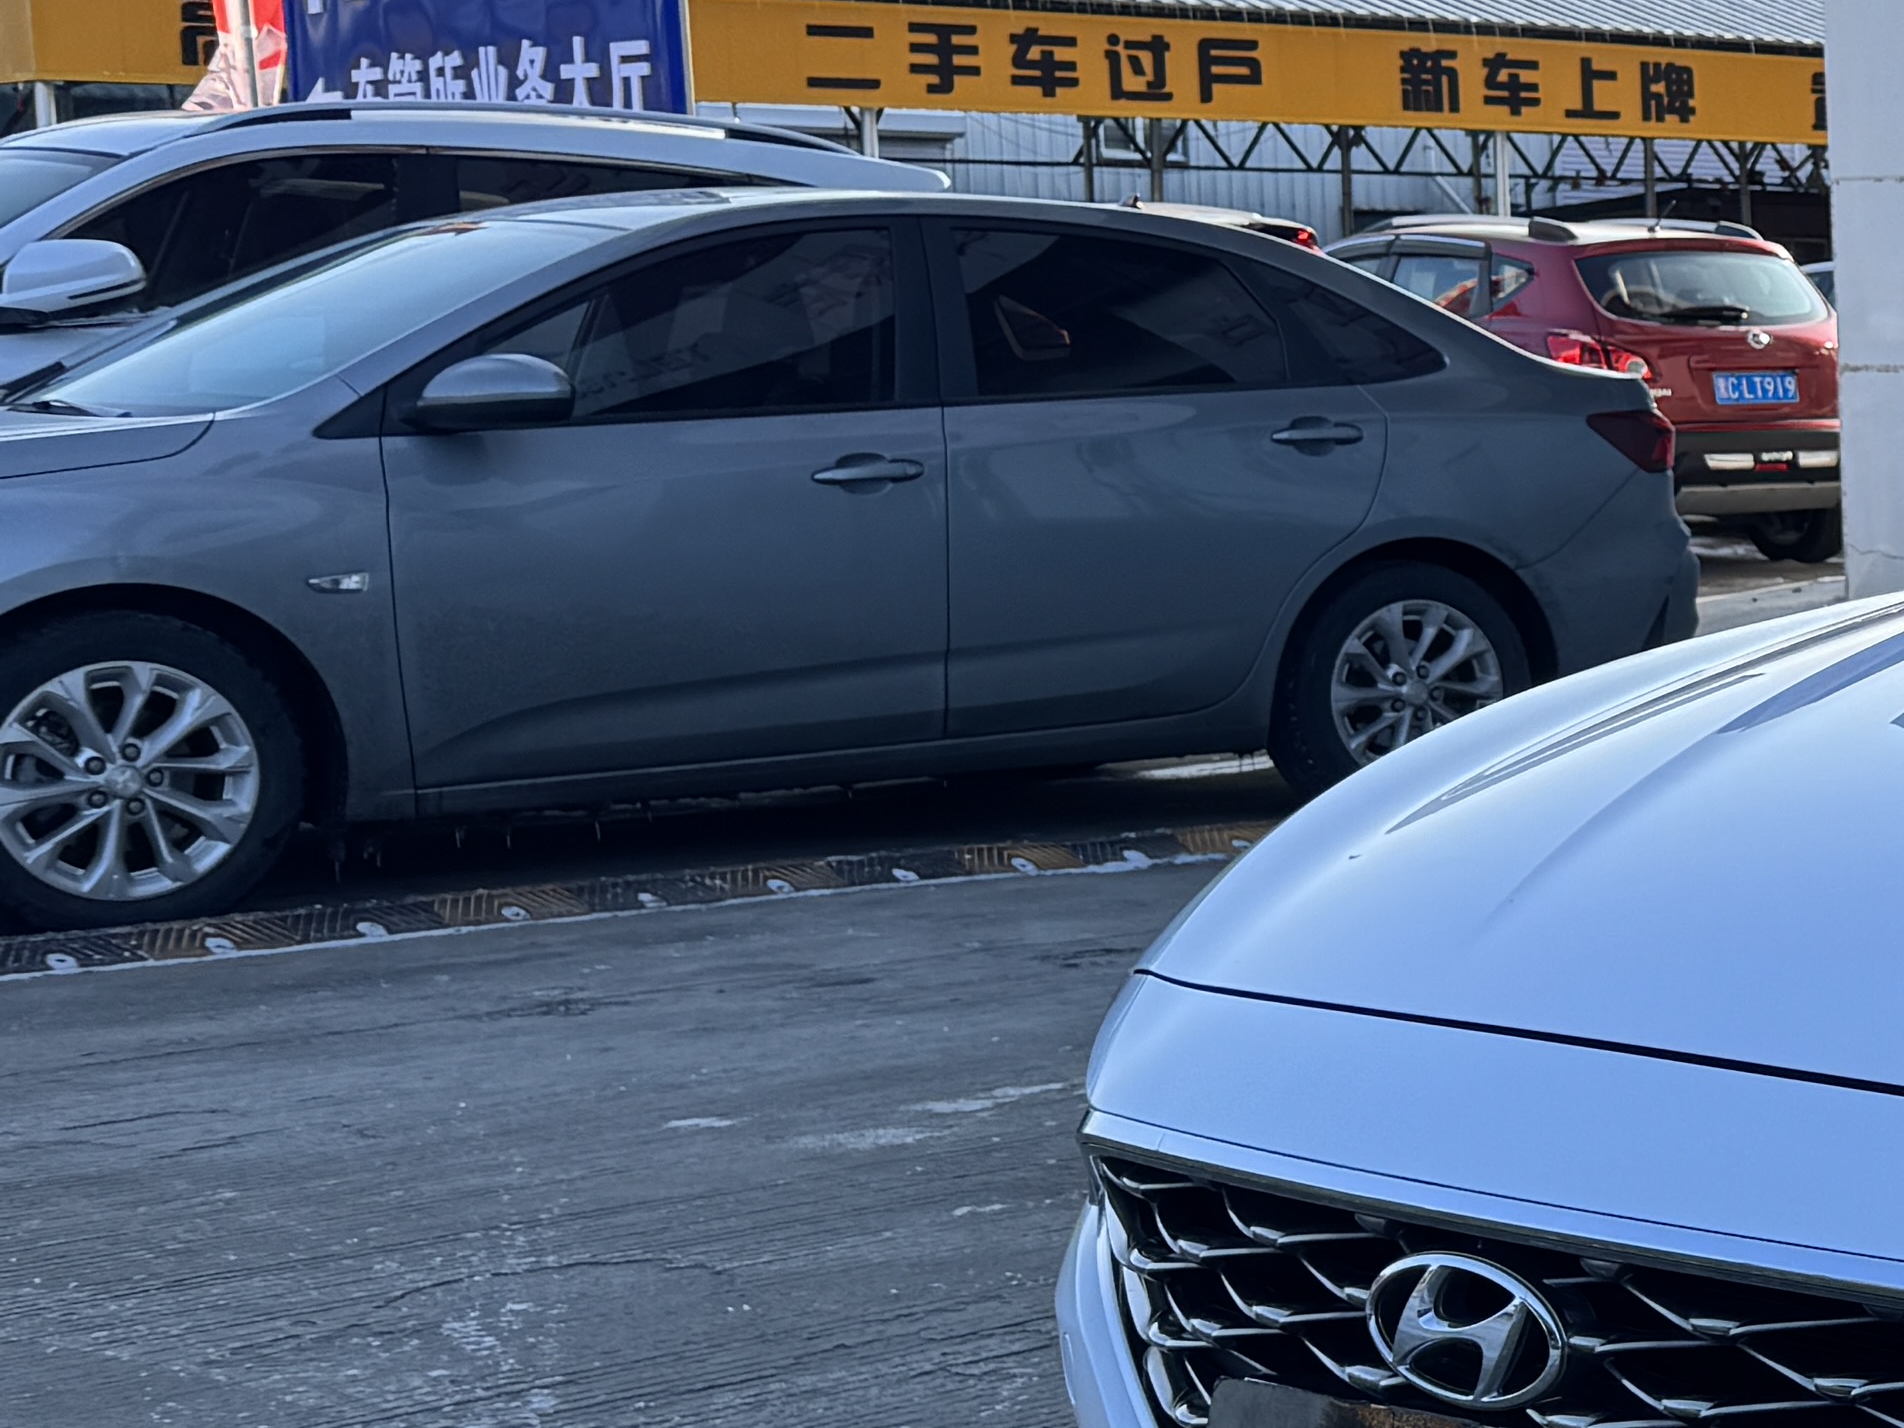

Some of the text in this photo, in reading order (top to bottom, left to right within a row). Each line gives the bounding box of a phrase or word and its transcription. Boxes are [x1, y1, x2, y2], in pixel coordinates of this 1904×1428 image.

[806, 21, 1697, 125] 二手车过户 新车上牌
